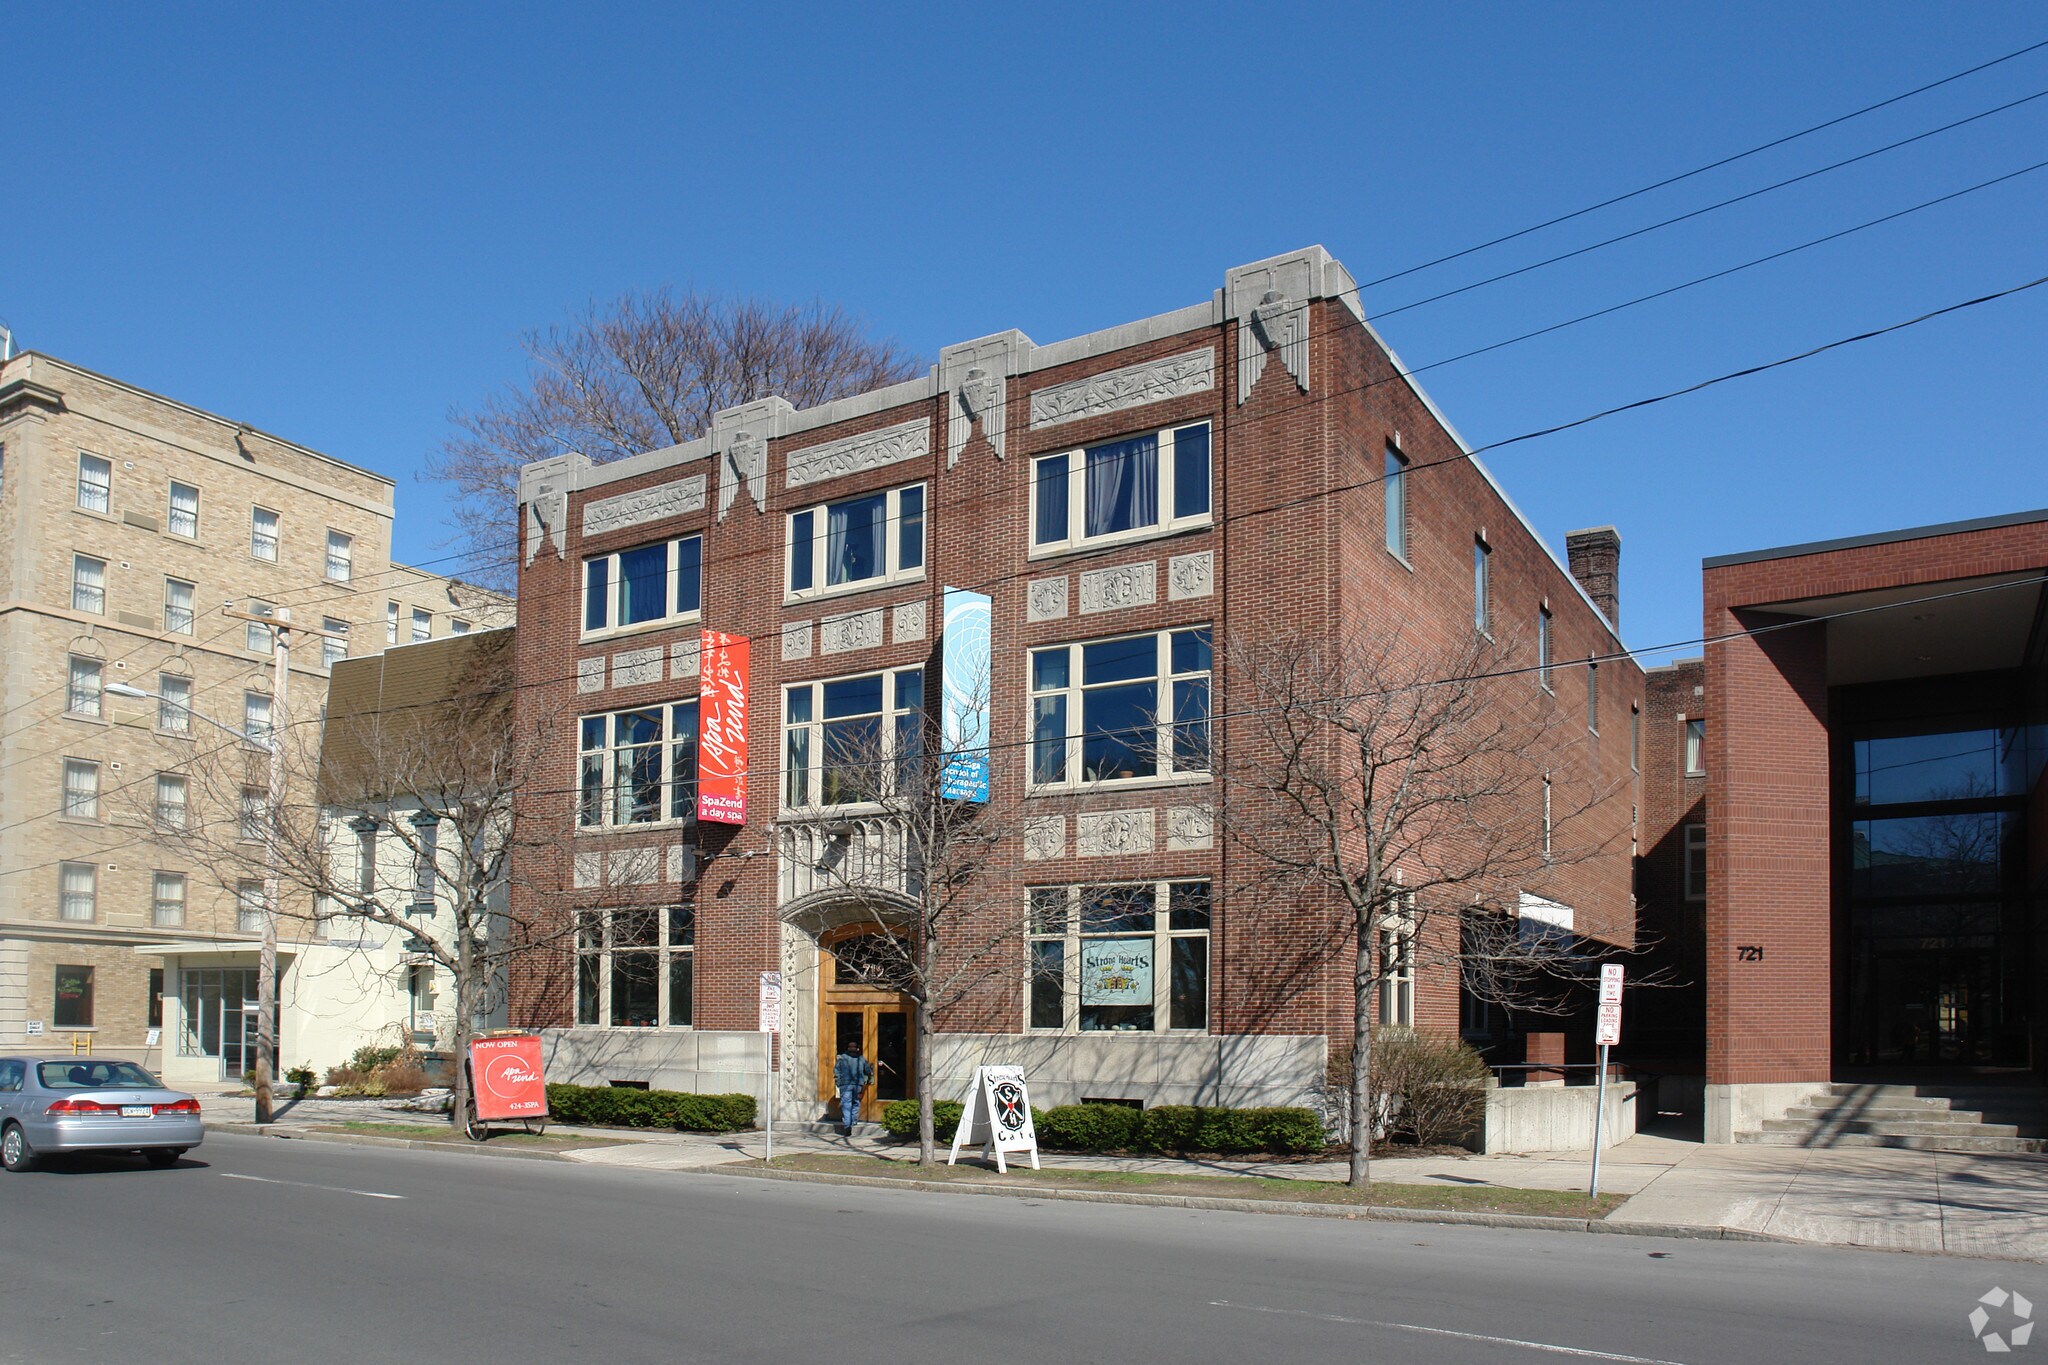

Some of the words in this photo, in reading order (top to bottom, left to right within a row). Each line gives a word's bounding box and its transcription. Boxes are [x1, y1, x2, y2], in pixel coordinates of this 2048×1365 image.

[971, 770, 979, 778] of
[702, 795, 743, 809] SpaZend
[710, 808, 726, 819] day
[727, 811, 743, 821] spa
[1736, 946, 1763, 961] 721
[475, 1041, 495, 1049] NOW
[497, 1040, 518, 1048] OPEN
